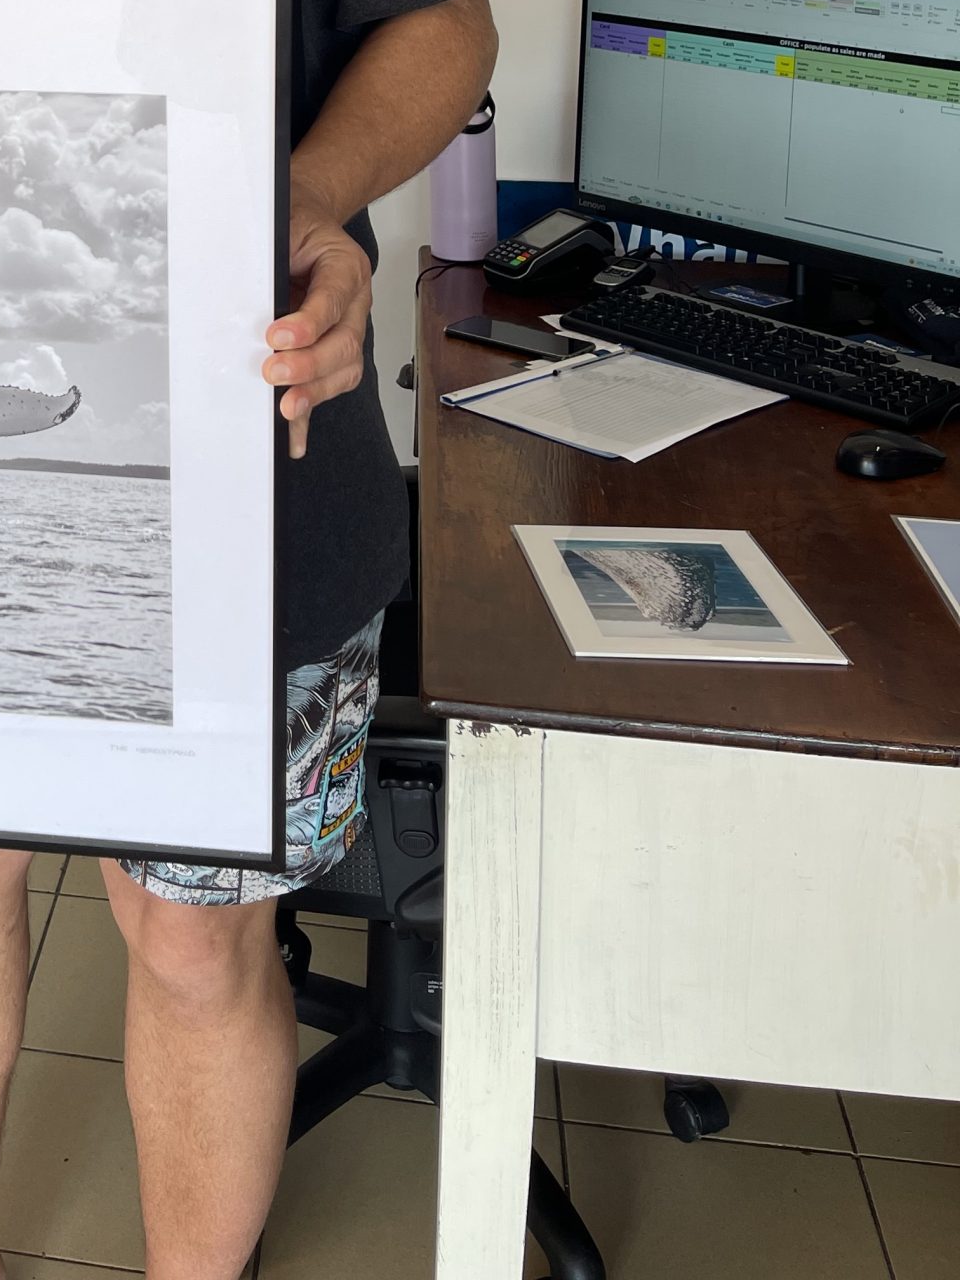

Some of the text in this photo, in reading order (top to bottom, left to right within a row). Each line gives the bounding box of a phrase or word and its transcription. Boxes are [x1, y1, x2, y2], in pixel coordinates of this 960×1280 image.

[780, 39, 800, 48] OFFICE
[804, 43, 831, 53] populate
[840, 47, 855, 56] sales
[868, 51, 886, 60] made
[578, 197, 607, 212] Lenovo
